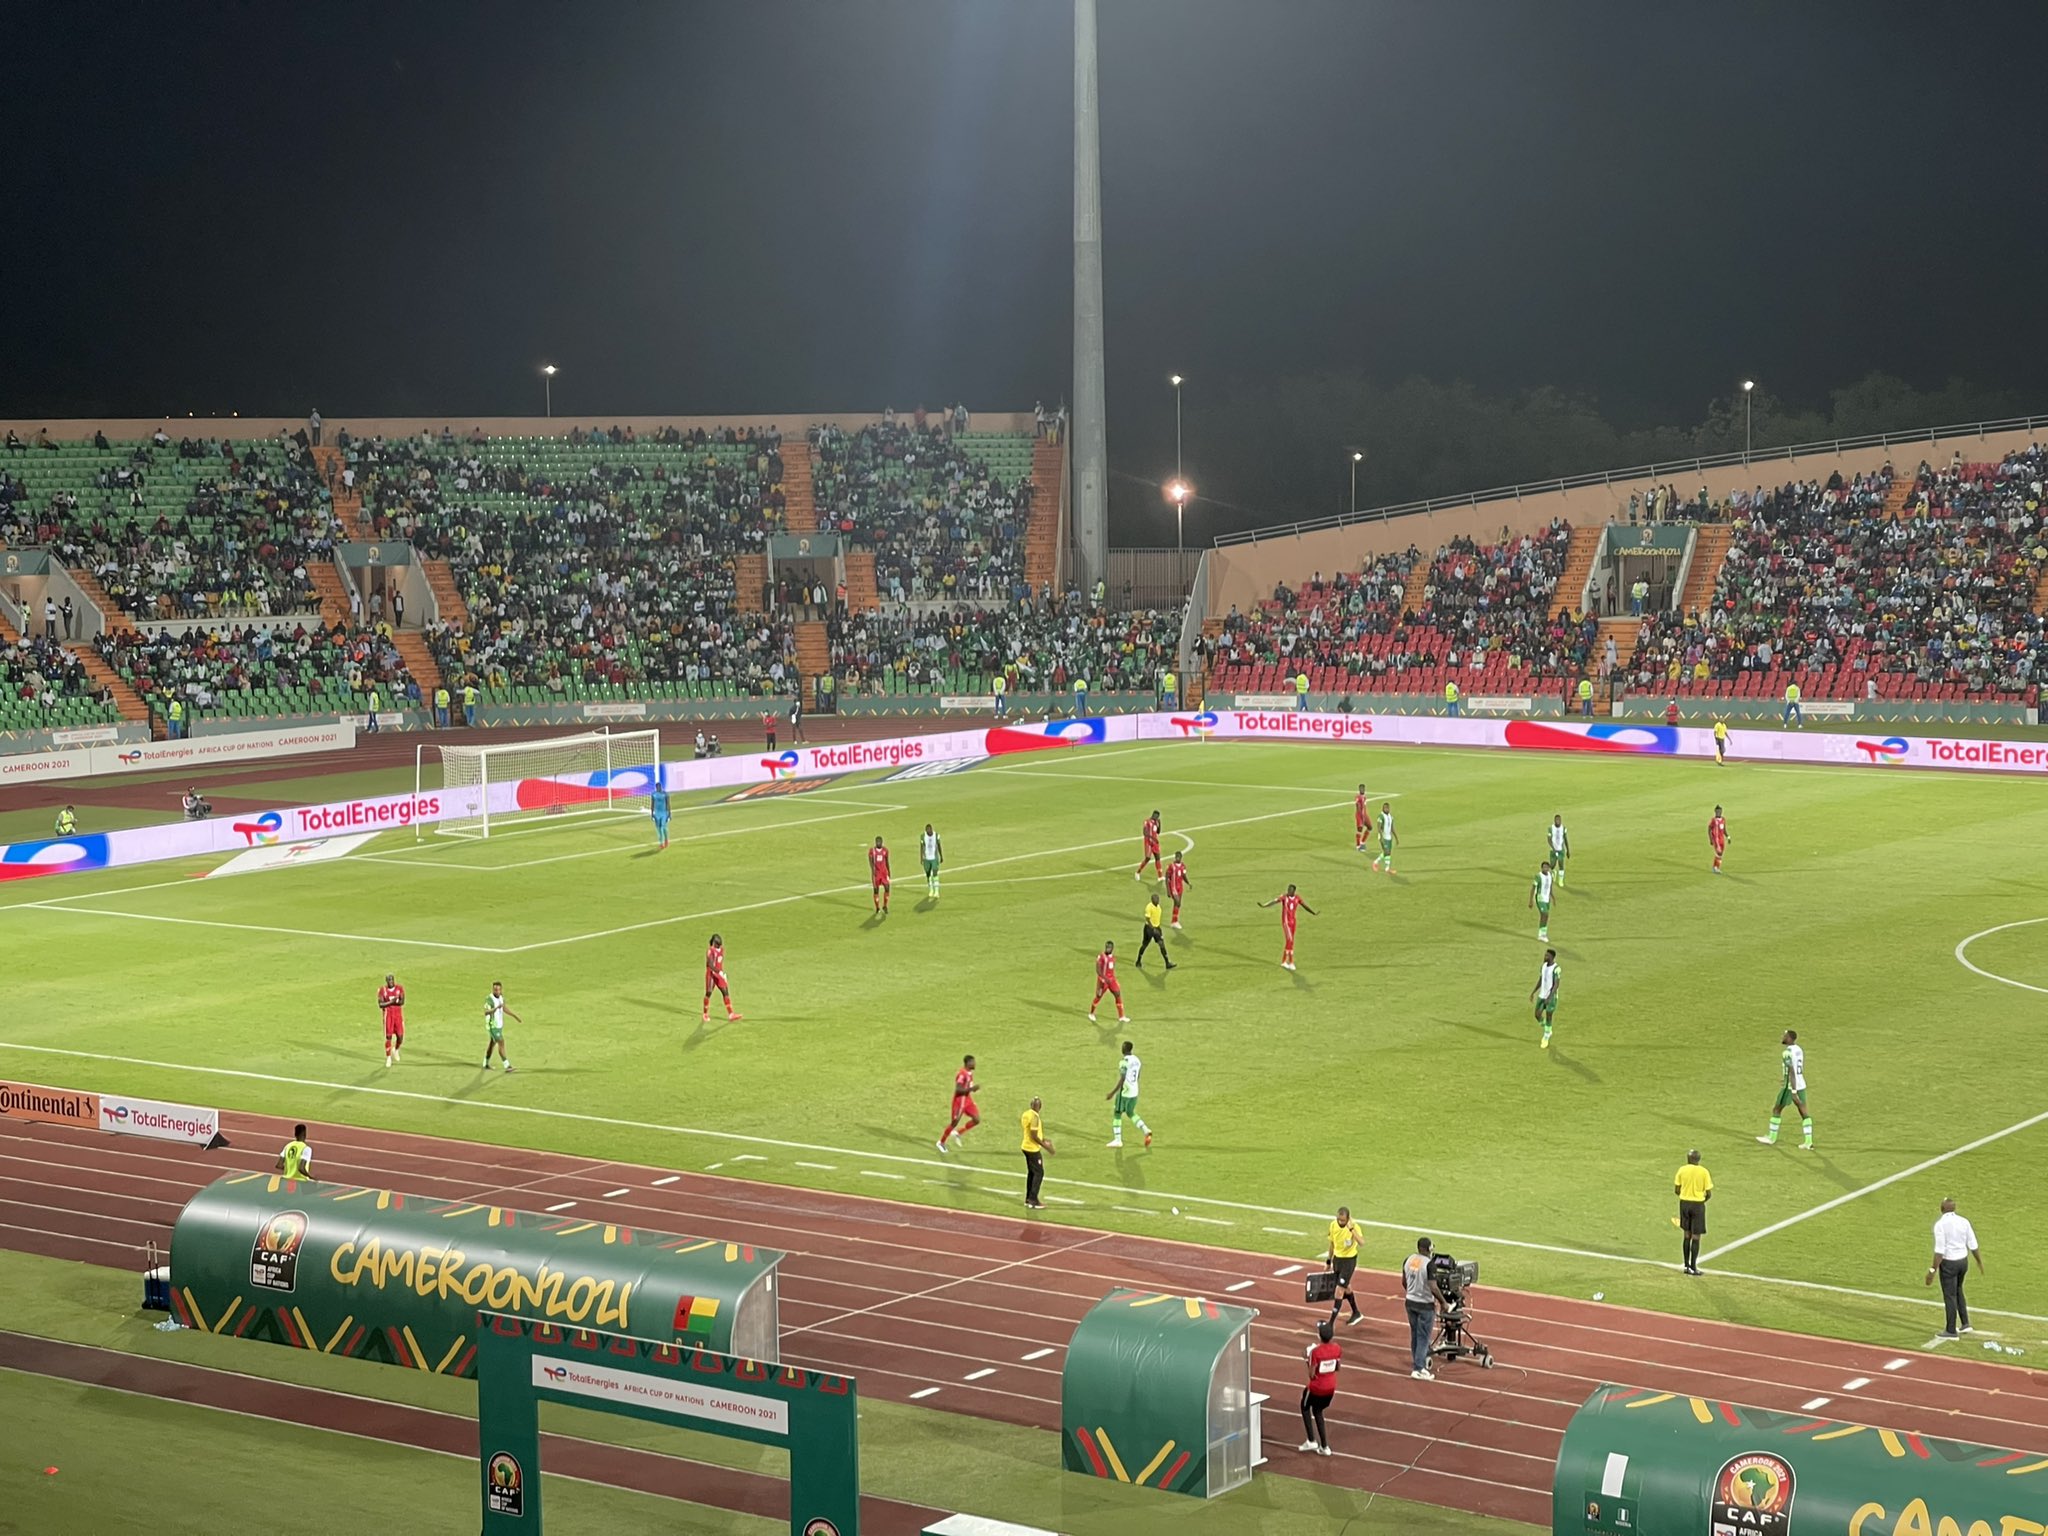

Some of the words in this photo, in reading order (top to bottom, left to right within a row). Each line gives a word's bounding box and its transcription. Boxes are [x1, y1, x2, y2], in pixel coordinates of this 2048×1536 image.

[1234, 712, 1373, 742] TotalEnergies
[143, 747, 193, 761] TotalEnergies
[198, 746, 221, 755] AFRICA
[223, 744, 236, 752] CUP
[236, 743, 245, 751] OF
[246, 740, 274, 750] NATIONS
[278, 735, 320, 746] CAMEROON
[321, 733, 337, 742] 2021
[810, 739, 923, 768] TotalEnergies
[2, 762, 50, 774] CAMEROON
[51, 760, 70, 769] 2021
[298, 794, 440, 826] TotalEnergies
[131, 1109, 213, 1137] TotalEnergies
[261, 1251, 288, 1264] CAF
[569, 1371, 619, 1390] TotalEnergies
[623, 1384, 648, 1395] AFRICA
[649, 1388, 663, 1398] CUP
[664, 1391, 673, 1399] OF
[675, 1393, 704, 1406] NATIONS
[709, 1399, 757, 1415] CAMEROON
[758, 1408, 777, 1420] 2021
[1729, 1457, 1775, 1474] CAMEROON
[1773, 1462, 1787, 1482] 2021
[1727, 1507, 1772, 1525] CAF
